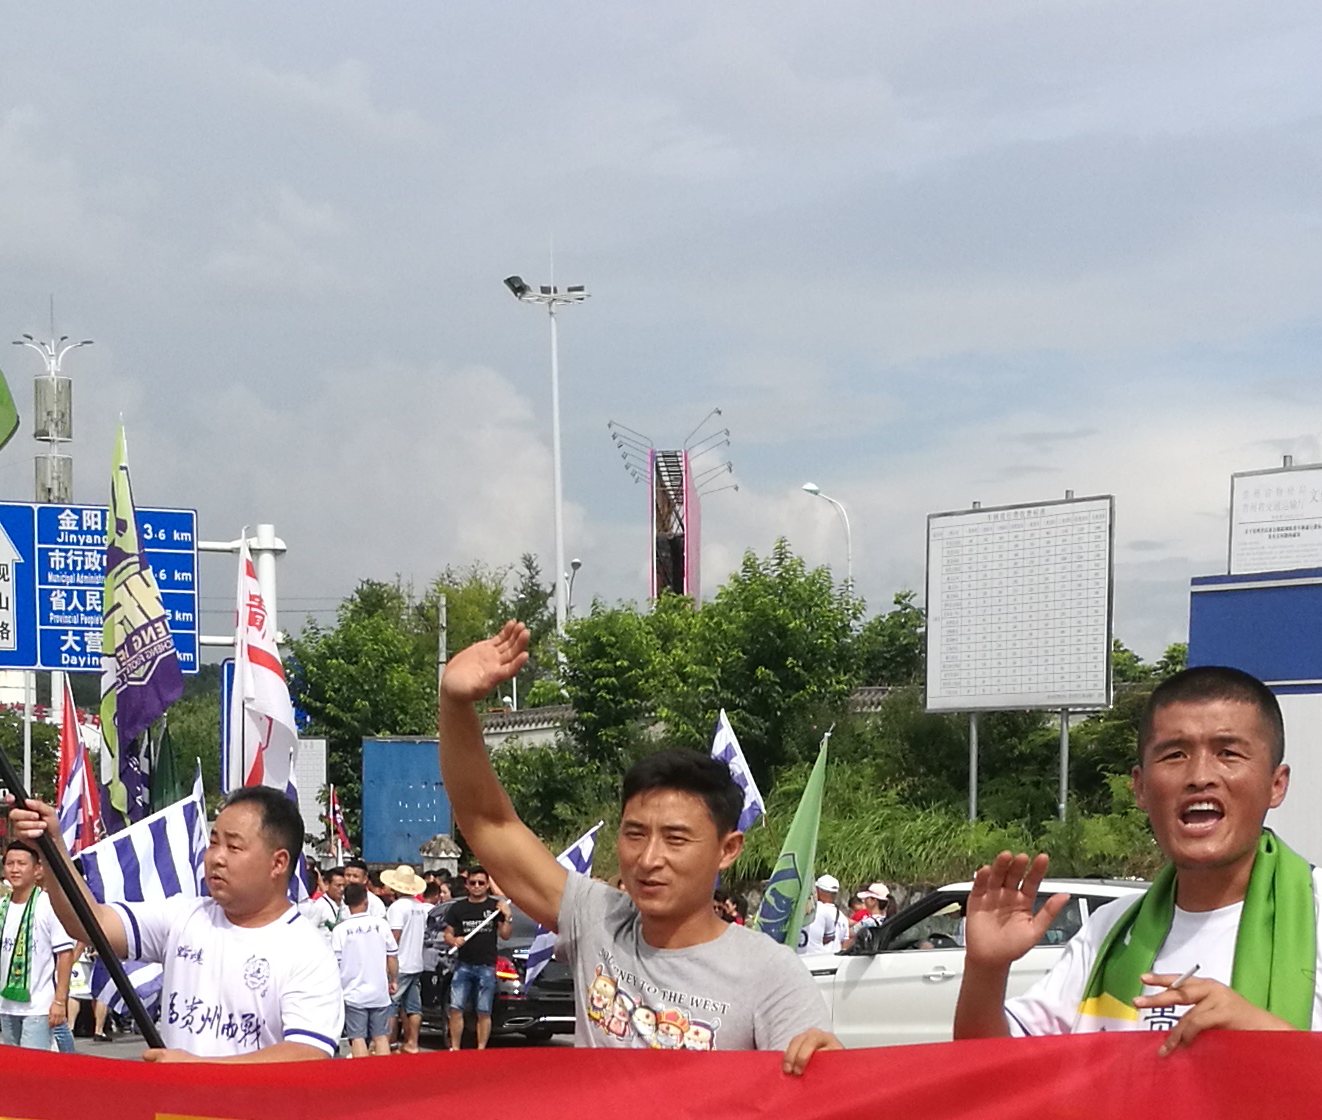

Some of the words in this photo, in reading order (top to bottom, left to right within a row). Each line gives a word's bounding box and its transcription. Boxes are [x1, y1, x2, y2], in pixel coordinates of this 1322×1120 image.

[57, 508, 109, 531] 金阳
[143, 523, 166, 541] 3.6
[173, 530, 192, 542] km
[47, 549, 107, 571] 市行政
[174, 570, 192, 582] km
[50, 590, 104, 612] 省人民
[176, 610, 193, 622] km
[61, 653, 99, 668] Dayin
[177, 651, 193, 662] km
[640, 980, 658, 994] TO
[661, 989, 687, 1004] THE
[690, 996, 730, 1015] WEST
